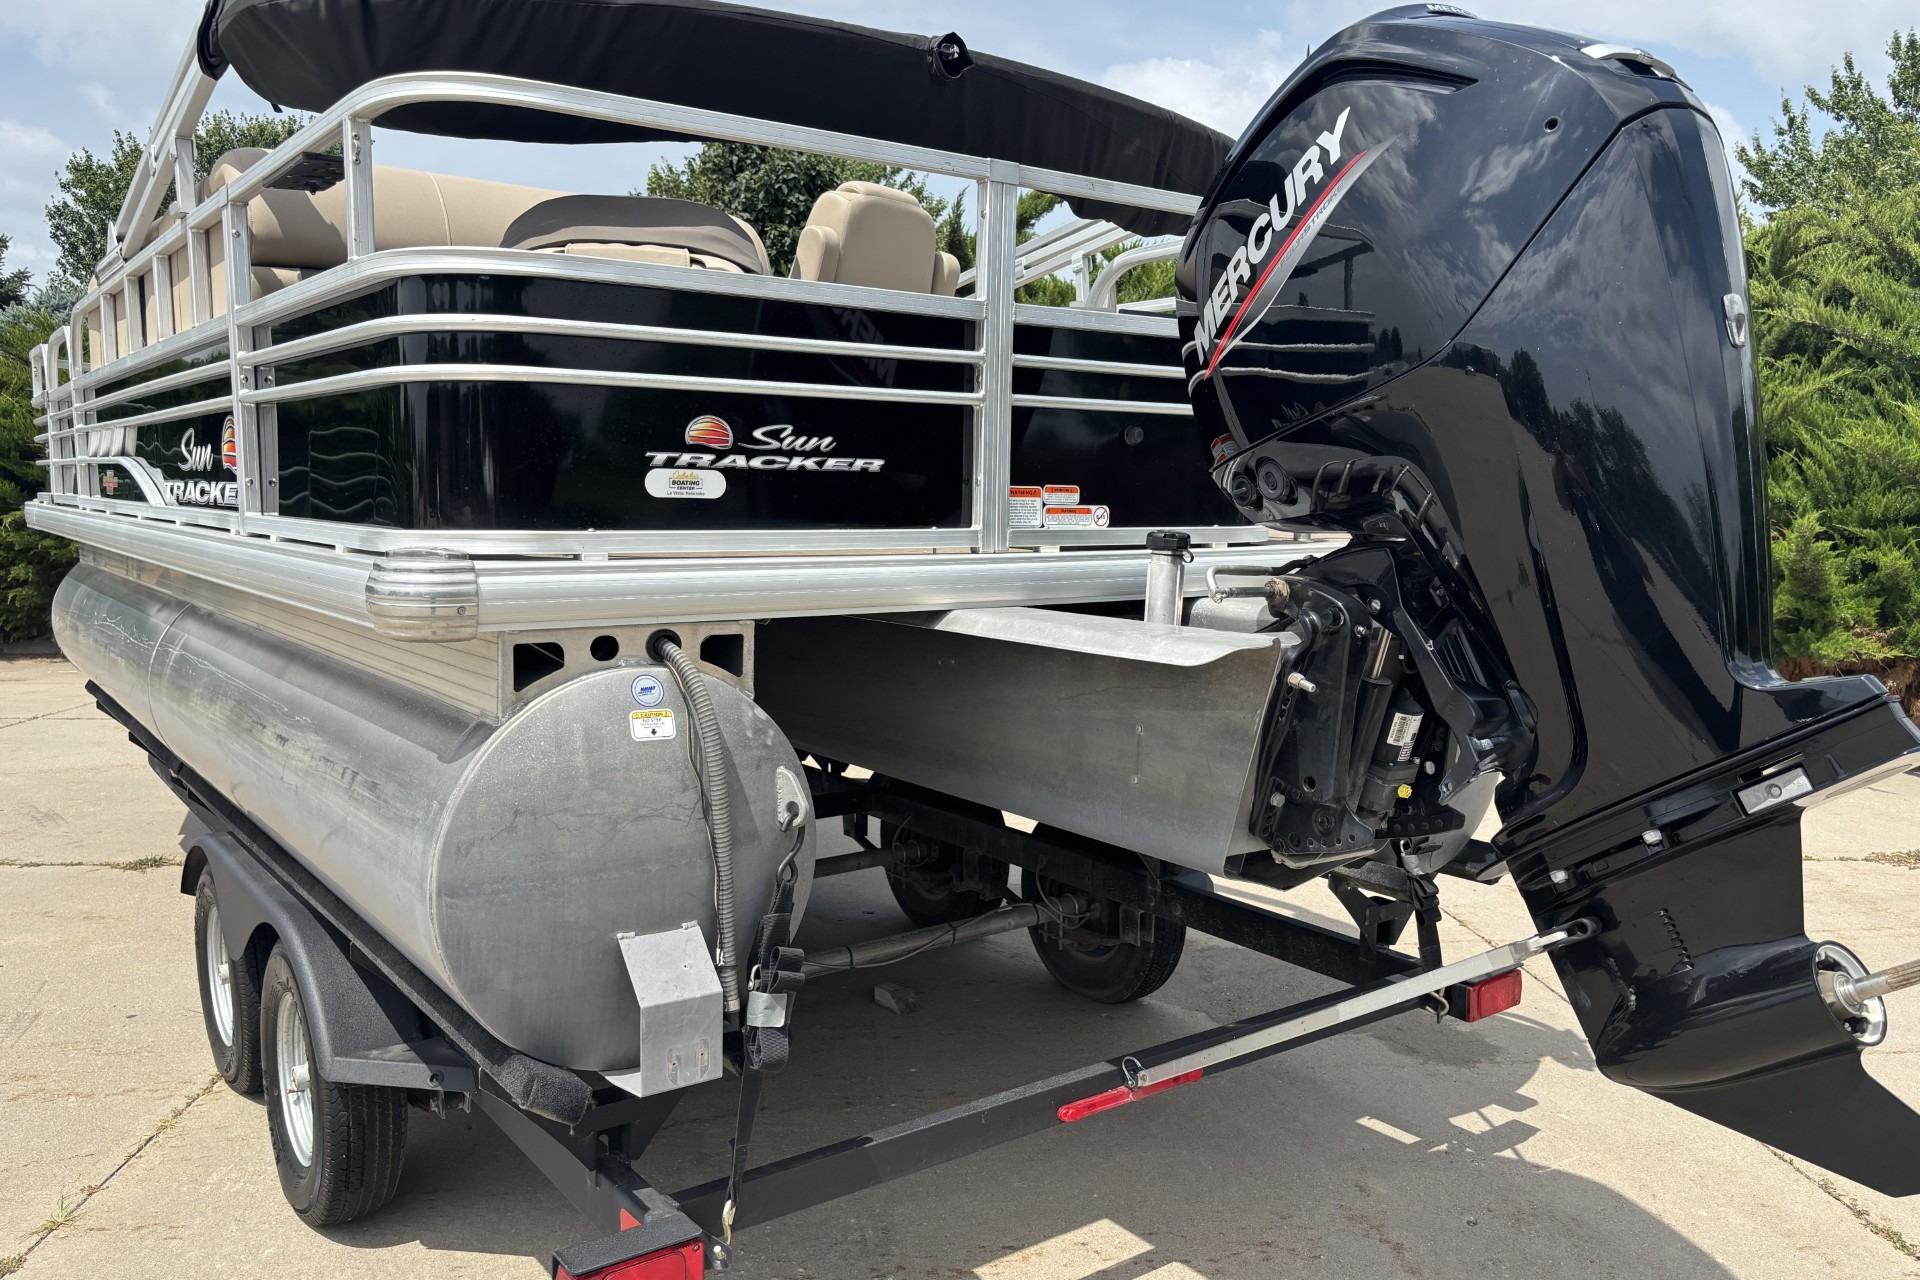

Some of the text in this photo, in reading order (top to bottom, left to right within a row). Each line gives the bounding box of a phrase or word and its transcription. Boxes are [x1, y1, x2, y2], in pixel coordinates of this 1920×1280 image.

[1193, 105, 1351, 366] MERCURY
[177, 427, 214, 472] Sun
[737, 424, 837, 451] Sun
[645, 451, 886, 472] TRACKER
[164, 481, 239, 507] TRACKE
